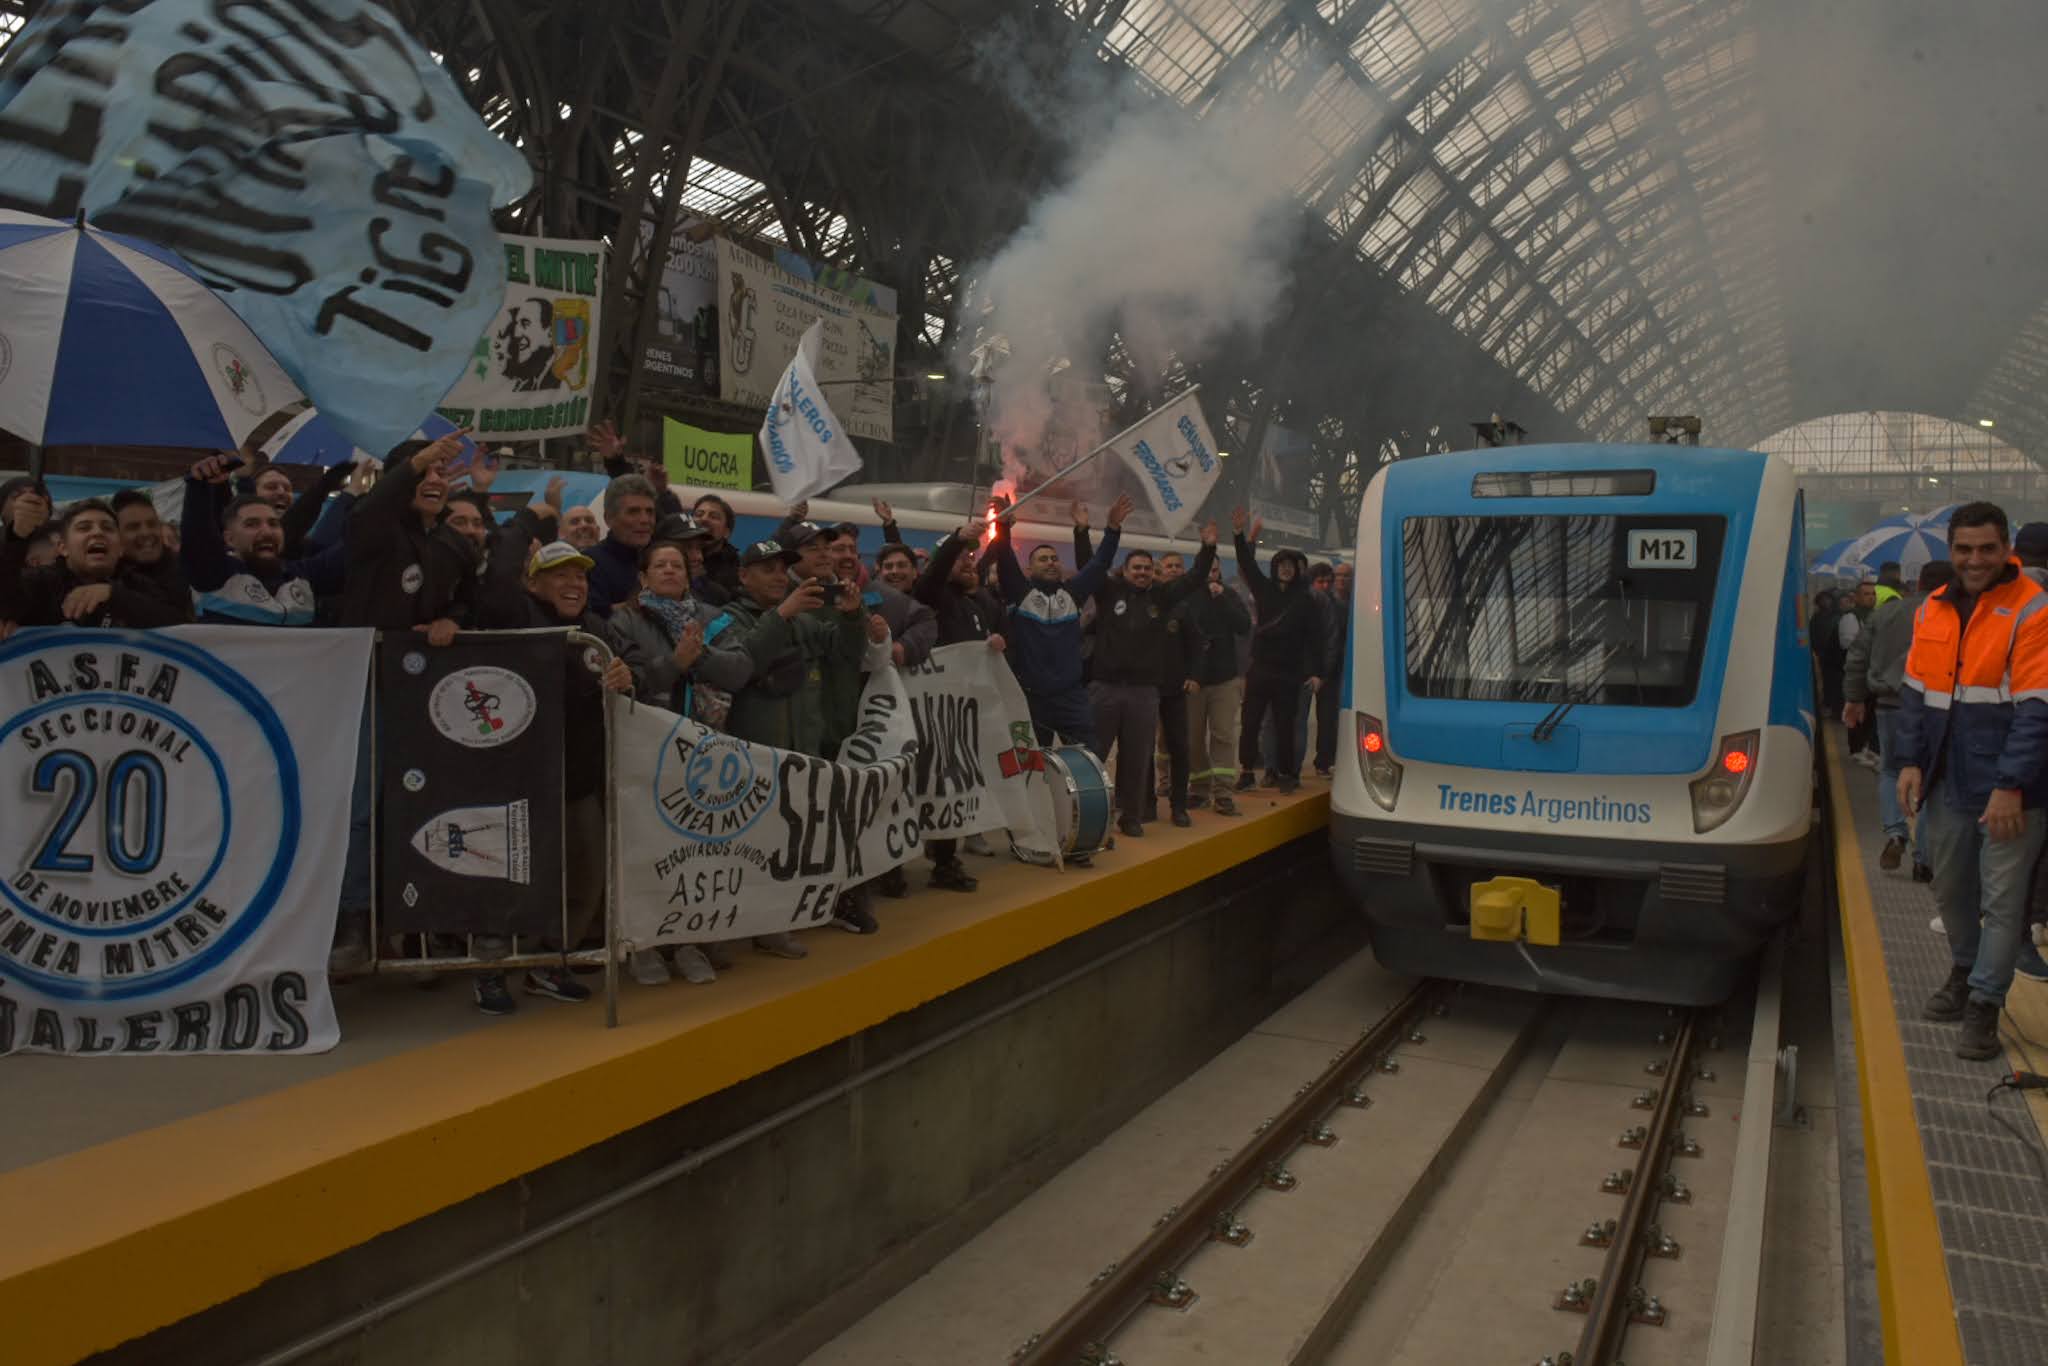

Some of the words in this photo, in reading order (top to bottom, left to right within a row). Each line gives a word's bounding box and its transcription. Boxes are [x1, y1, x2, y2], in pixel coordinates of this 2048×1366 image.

[685, 445, 738, 475] UOCRA
[1640, 538, 1686, 561] M12
[30, 653, 178, 702] A.S.F.A
[22, 707, 192, 763] SECCIONAL
[687, 752, 740, 794] 20
[32, 749, 167, 875] 20
[661, 787, 715, 834] LINEA
[721, 775, 771, 833] MITRE
[1438, 783, 1516, 816] Trenes
[1521, 790, 1651, 823] Argentinos
[15, 871, 49, 903] DE
[50, 872, 190, 922] NOVIEMBRE
[668, 867, 744, 906] ASFU
[0, 907, 82, 974] INEA
[105, 898, 227, 975] MITRE
[656, 904, 737, 937] 2011
[0, 972, 308, 1052] ALEROS
